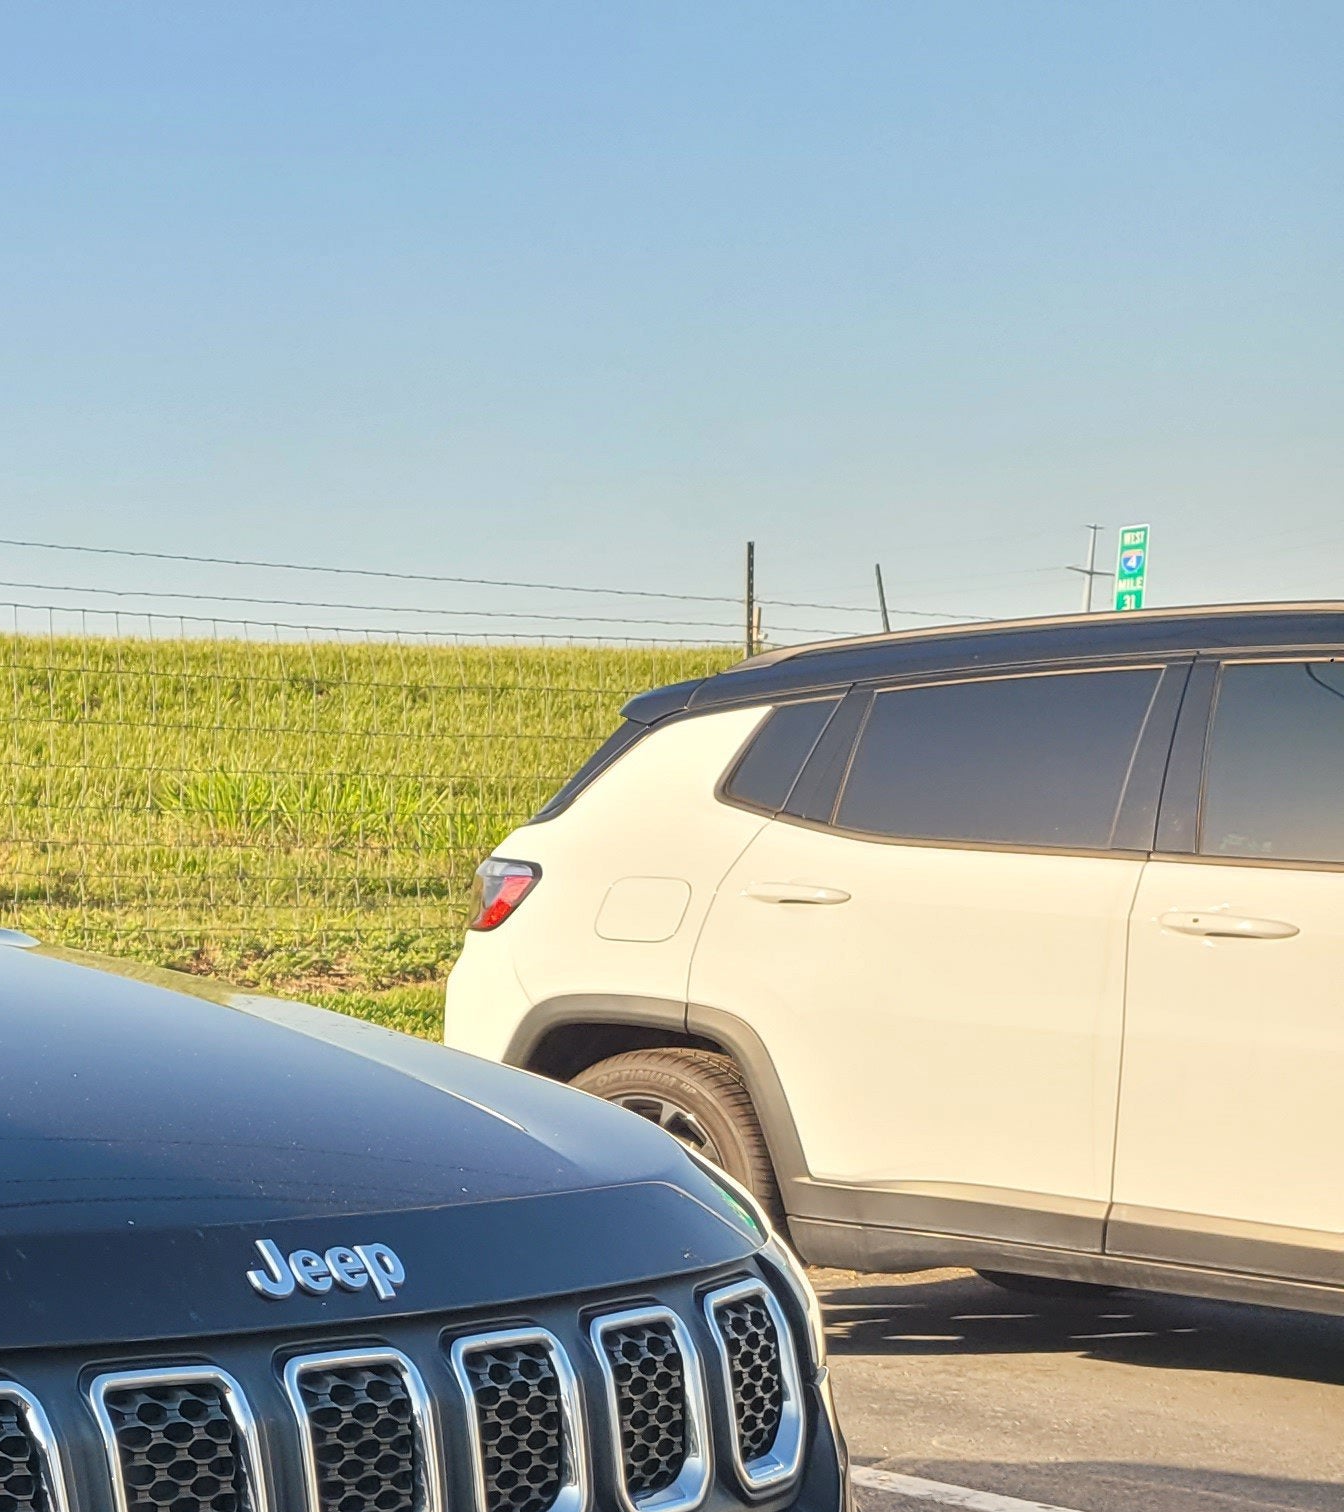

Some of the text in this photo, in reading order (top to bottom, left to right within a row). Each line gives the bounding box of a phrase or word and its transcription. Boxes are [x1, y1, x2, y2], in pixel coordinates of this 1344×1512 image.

[1124, 531, 1145, 545] WEST
[1126, 555, 1137, 568] 4
[1117, 576, 1144, 592] MILE
[1121, 595, 1135, 610] 31
[595, 1069, 677, 1088] OPTIMUM
[246, 1239, 405, 1300] Jeep
